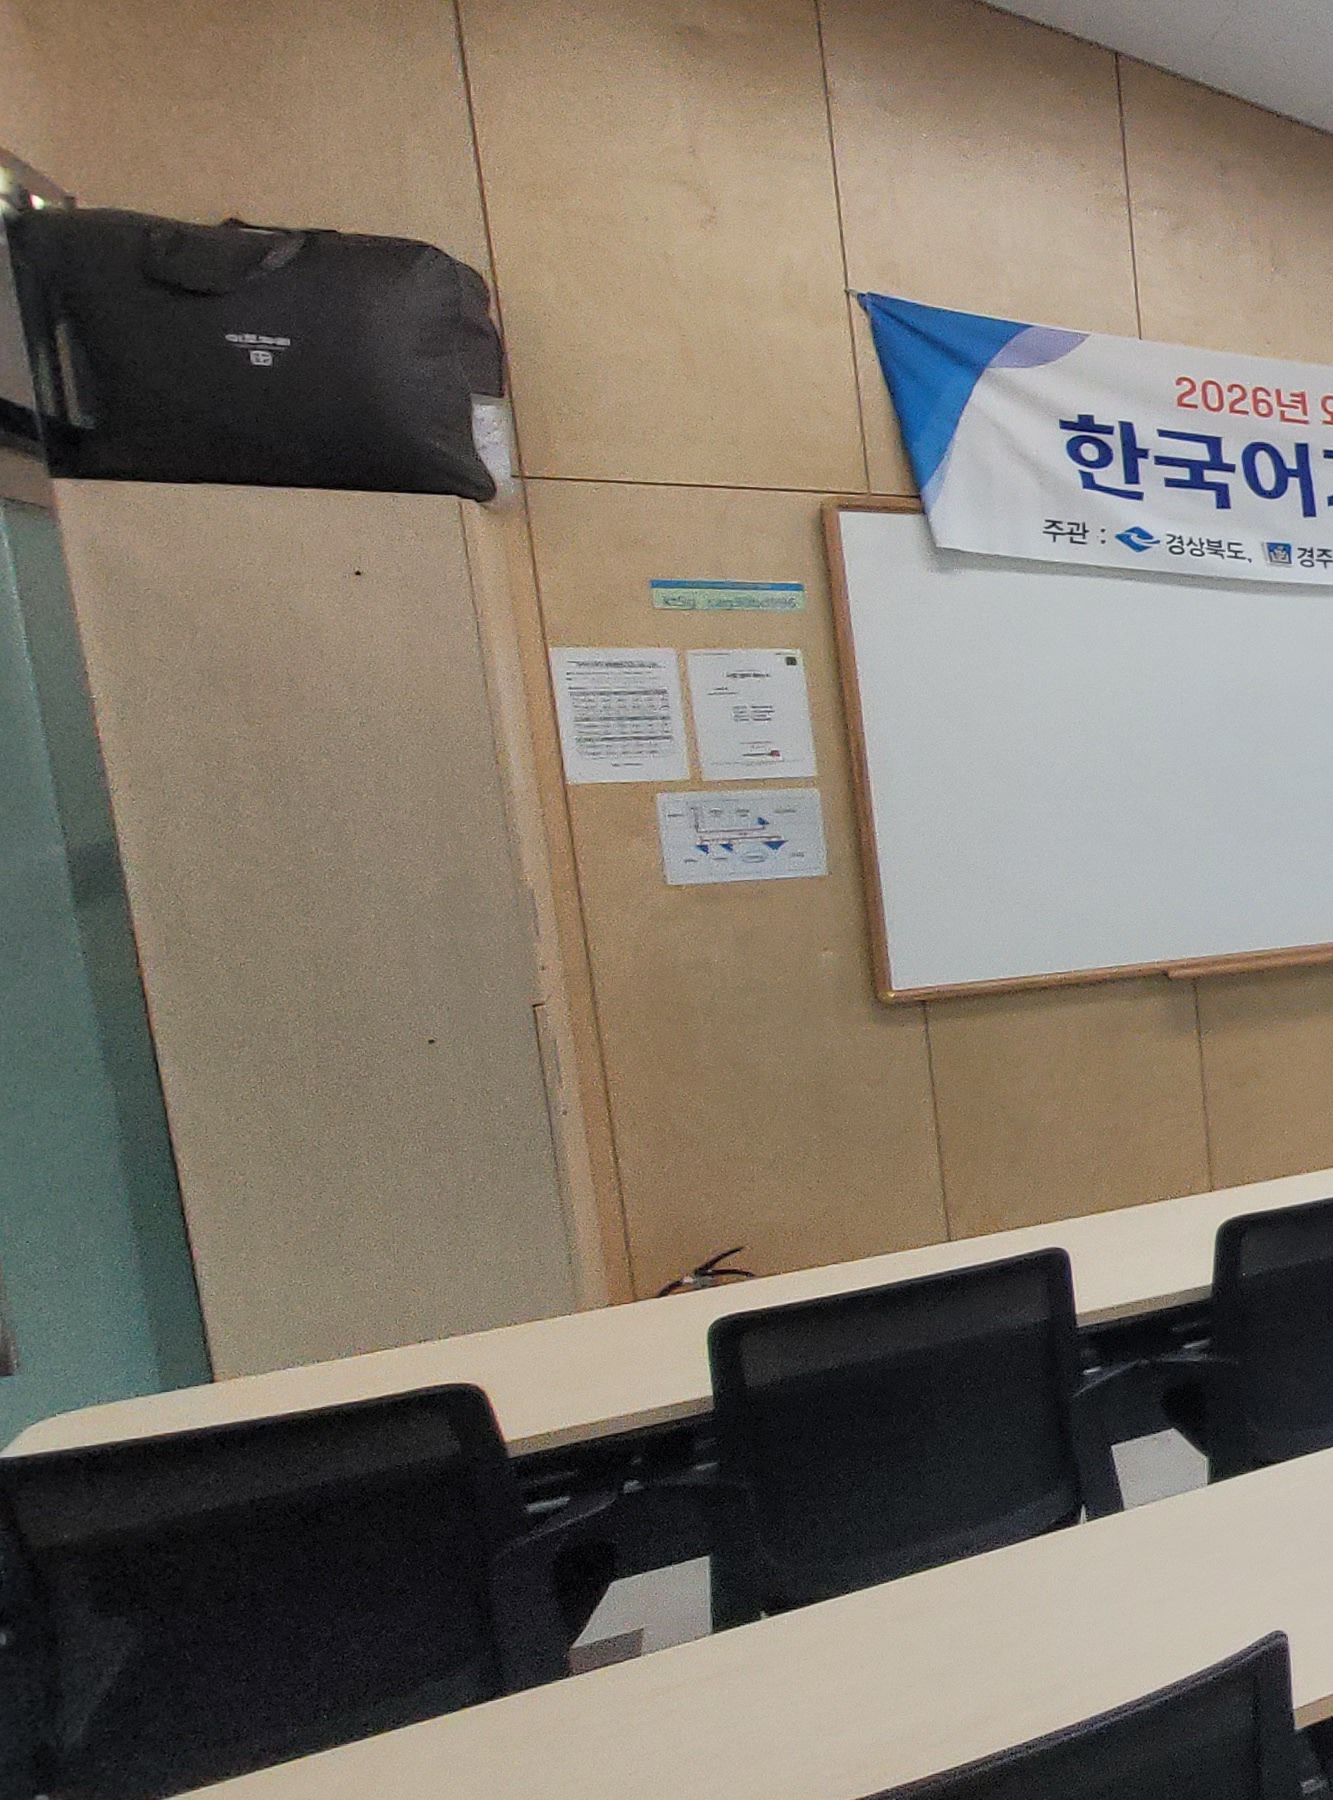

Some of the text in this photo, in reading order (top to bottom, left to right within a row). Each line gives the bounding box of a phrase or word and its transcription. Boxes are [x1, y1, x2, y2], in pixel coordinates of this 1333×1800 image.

[1175, 375, 1309, 425] 2026년
[1042, 518, 1090, 545] 주관
[1165, 532, 1254, 564] 경상북도,
